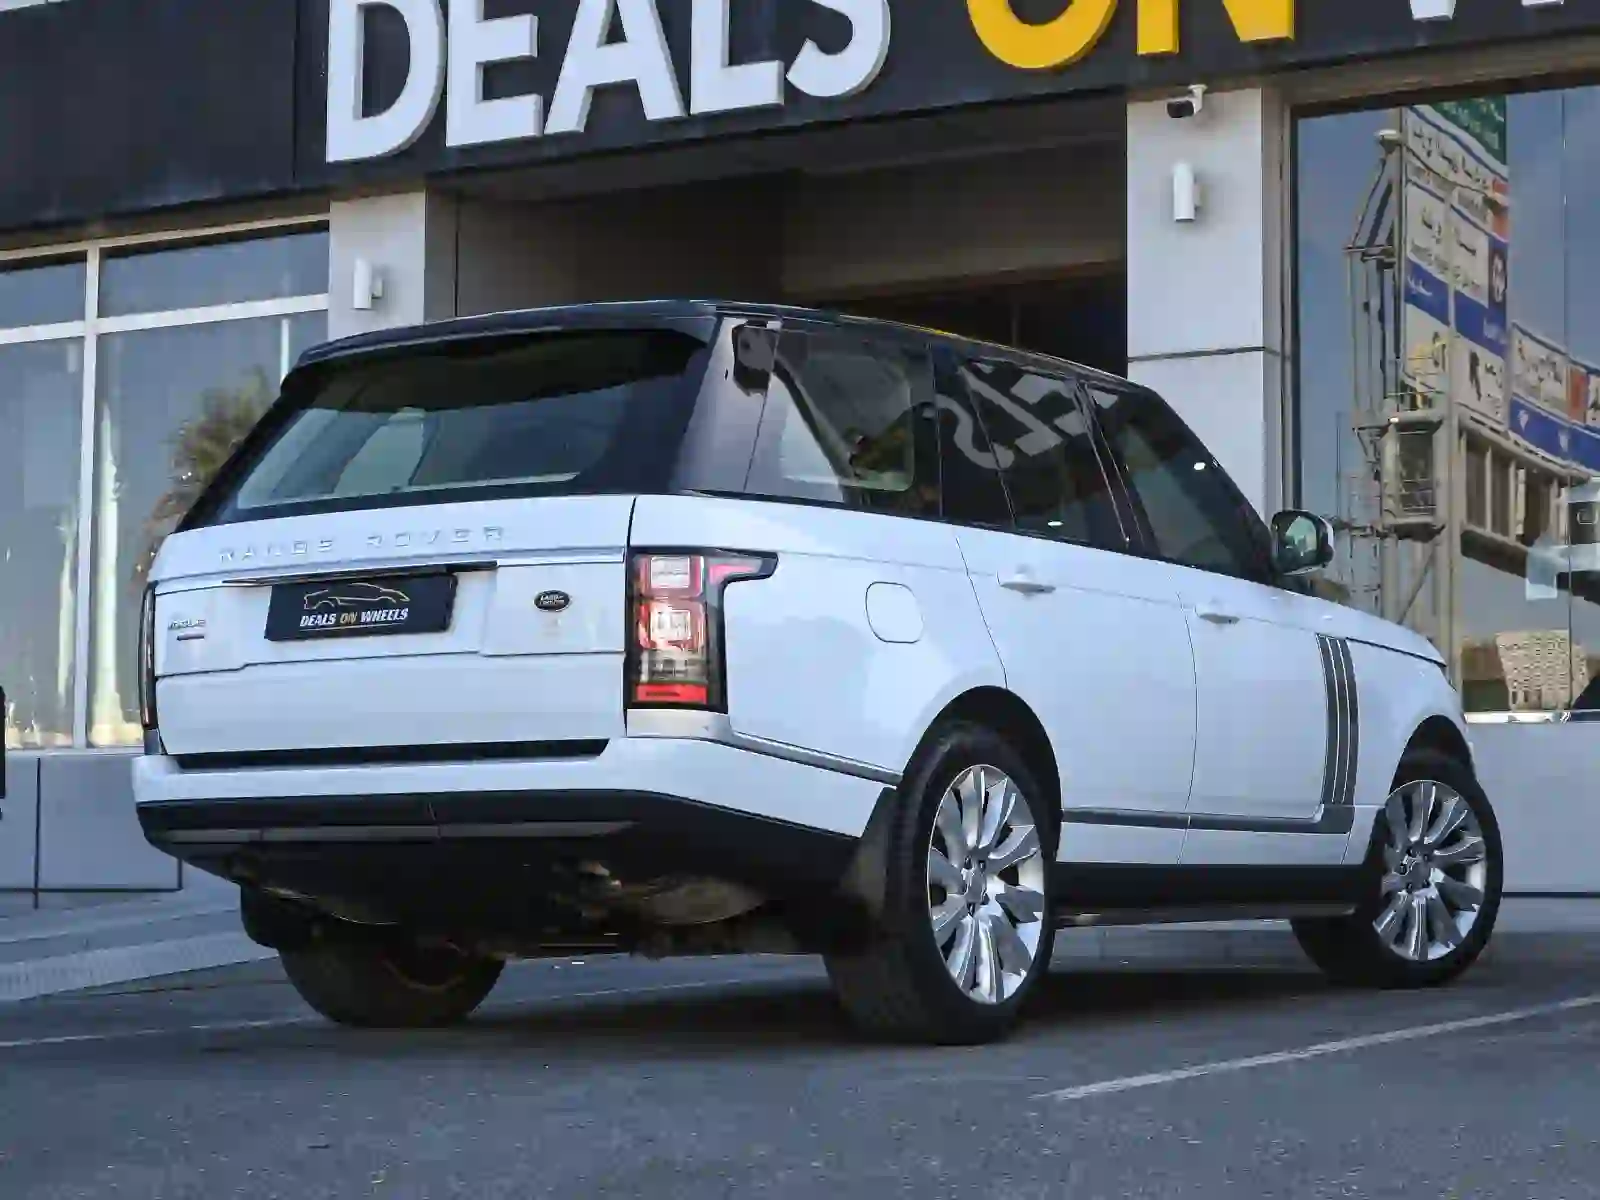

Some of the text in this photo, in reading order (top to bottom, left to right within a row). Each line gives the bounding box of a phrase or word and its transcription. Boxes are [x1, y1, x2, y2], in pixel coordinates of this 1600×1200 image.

[367, 525, 504, 548] ROVER
[299, 608, 410, 627] DEALS ON WHEELS
